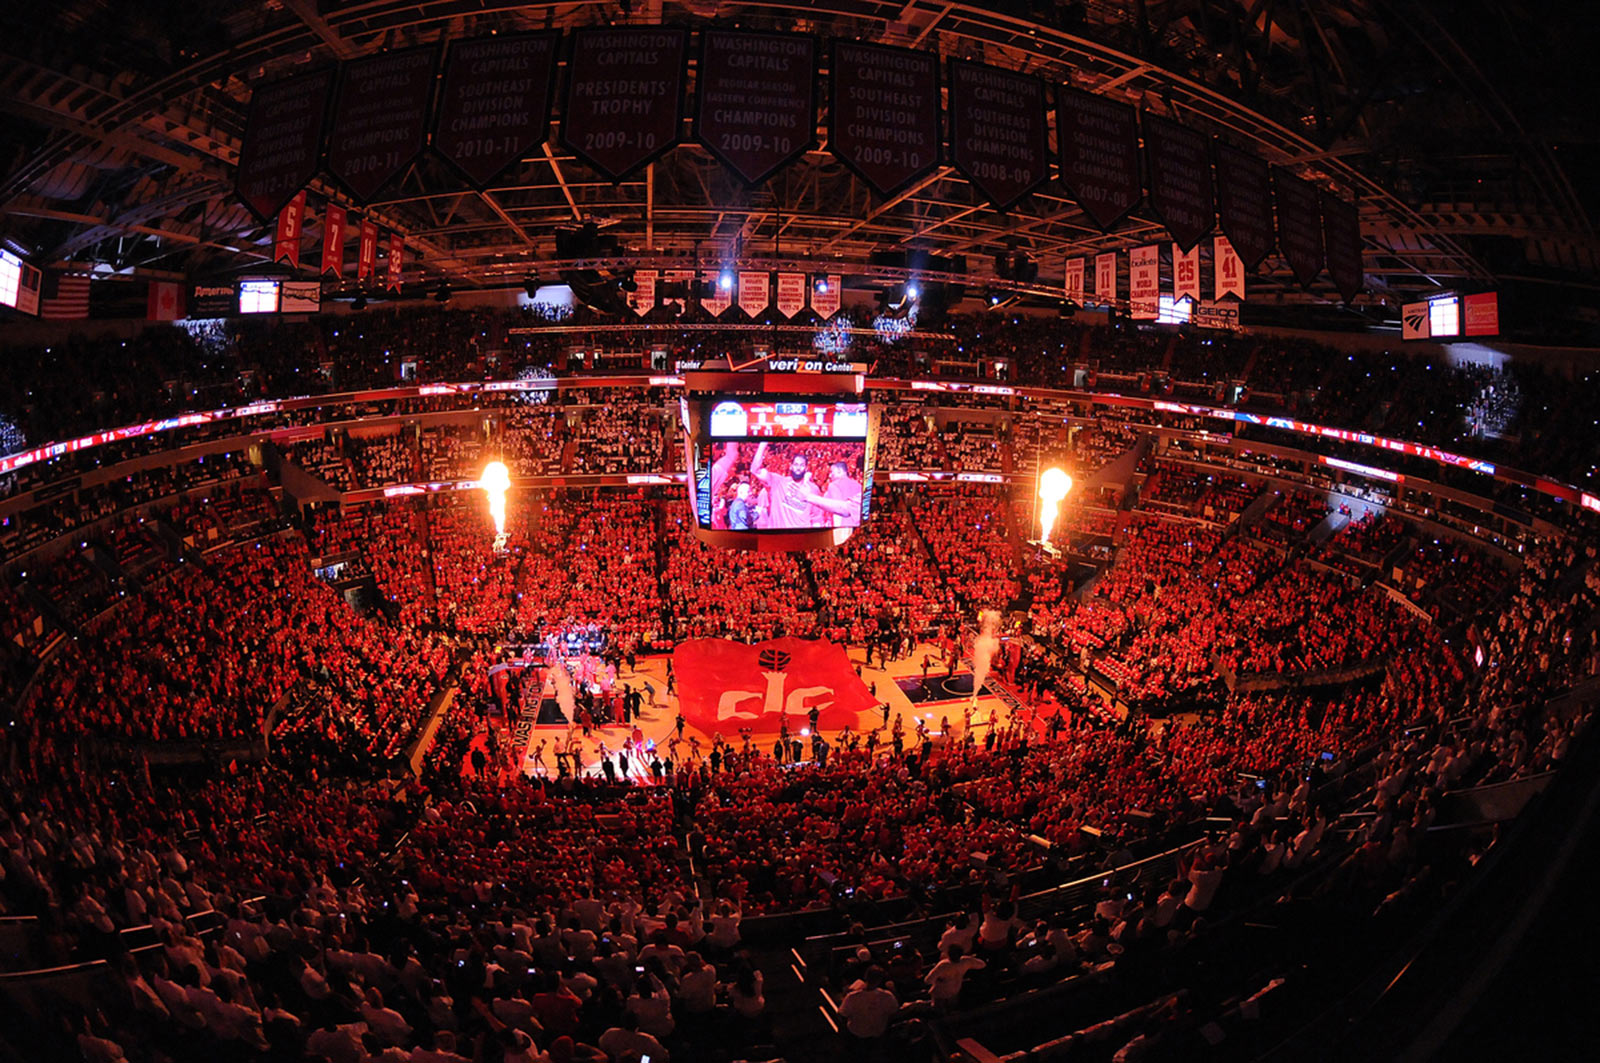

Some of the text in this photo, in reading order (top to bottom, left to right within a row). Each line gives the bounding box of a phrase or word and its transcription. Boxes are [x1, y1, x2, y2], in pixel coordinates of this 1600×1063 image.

[461, 39, 548, 60] WASHINGTON
[584, 35, 676, 49] WASHINGTON
[712, 36, 808, 56] WASHINGTON
[471, 57, 529, 75] CAPITALS
[597, 51, 658, 65] CAPITALS
[728, 54, 789, 71] CAPITALS
[842, 50, 929, 73] WASHINGTON
[576, 80, 671, 96] PRESIDENTS'
[857, 67, 916, 88] CAPITALS
[959, 68, 1036, 97] WASHINGTON
[458, 79, 533, 98] SOUTHEAST
[849, 86, 922, 107] SOUTHEAST
[974, 87, 1025, 109] CAPITALS
[463, 96, 523, 114] DIVISION
[592, 100, 652, 115] TROPHY
[856, 104, 916, 125] DIVISION
[452, 112, 529, 132] CHAMPIONS
[714, 109, 797, 128] CHAMPIONS
[967, 106, 1031, 129] SOUTHEAST
[585, 132, 655, 150] 2009-10
[721, 133, 791, 153] 2009-10
[848, 122, 924, 145] CHAMPIONS
[974, 123, 1027, 143] DIVISION
[456, 136, 519, 158] 2010-11
[854, 145, 919, 169] 2009-10
[966, 137, 1034, 162] CHAMPIONS
[972, 160, 1031, 185] 2008-09
[1079, 183, 1129, 208] 2007-08
[286, 206, 297, 237] 5
[331, 224, 339, 252] 7
[364, 238, 372, 263] 11
[1178, 260, 1194, 282] 25
[1222, 256, 1237, 278] 41
[1101, 271, 1110, 289] 11
[1198, 306, 1238, 317] GEICO
[769, 358, 854, 373] verizon Center
